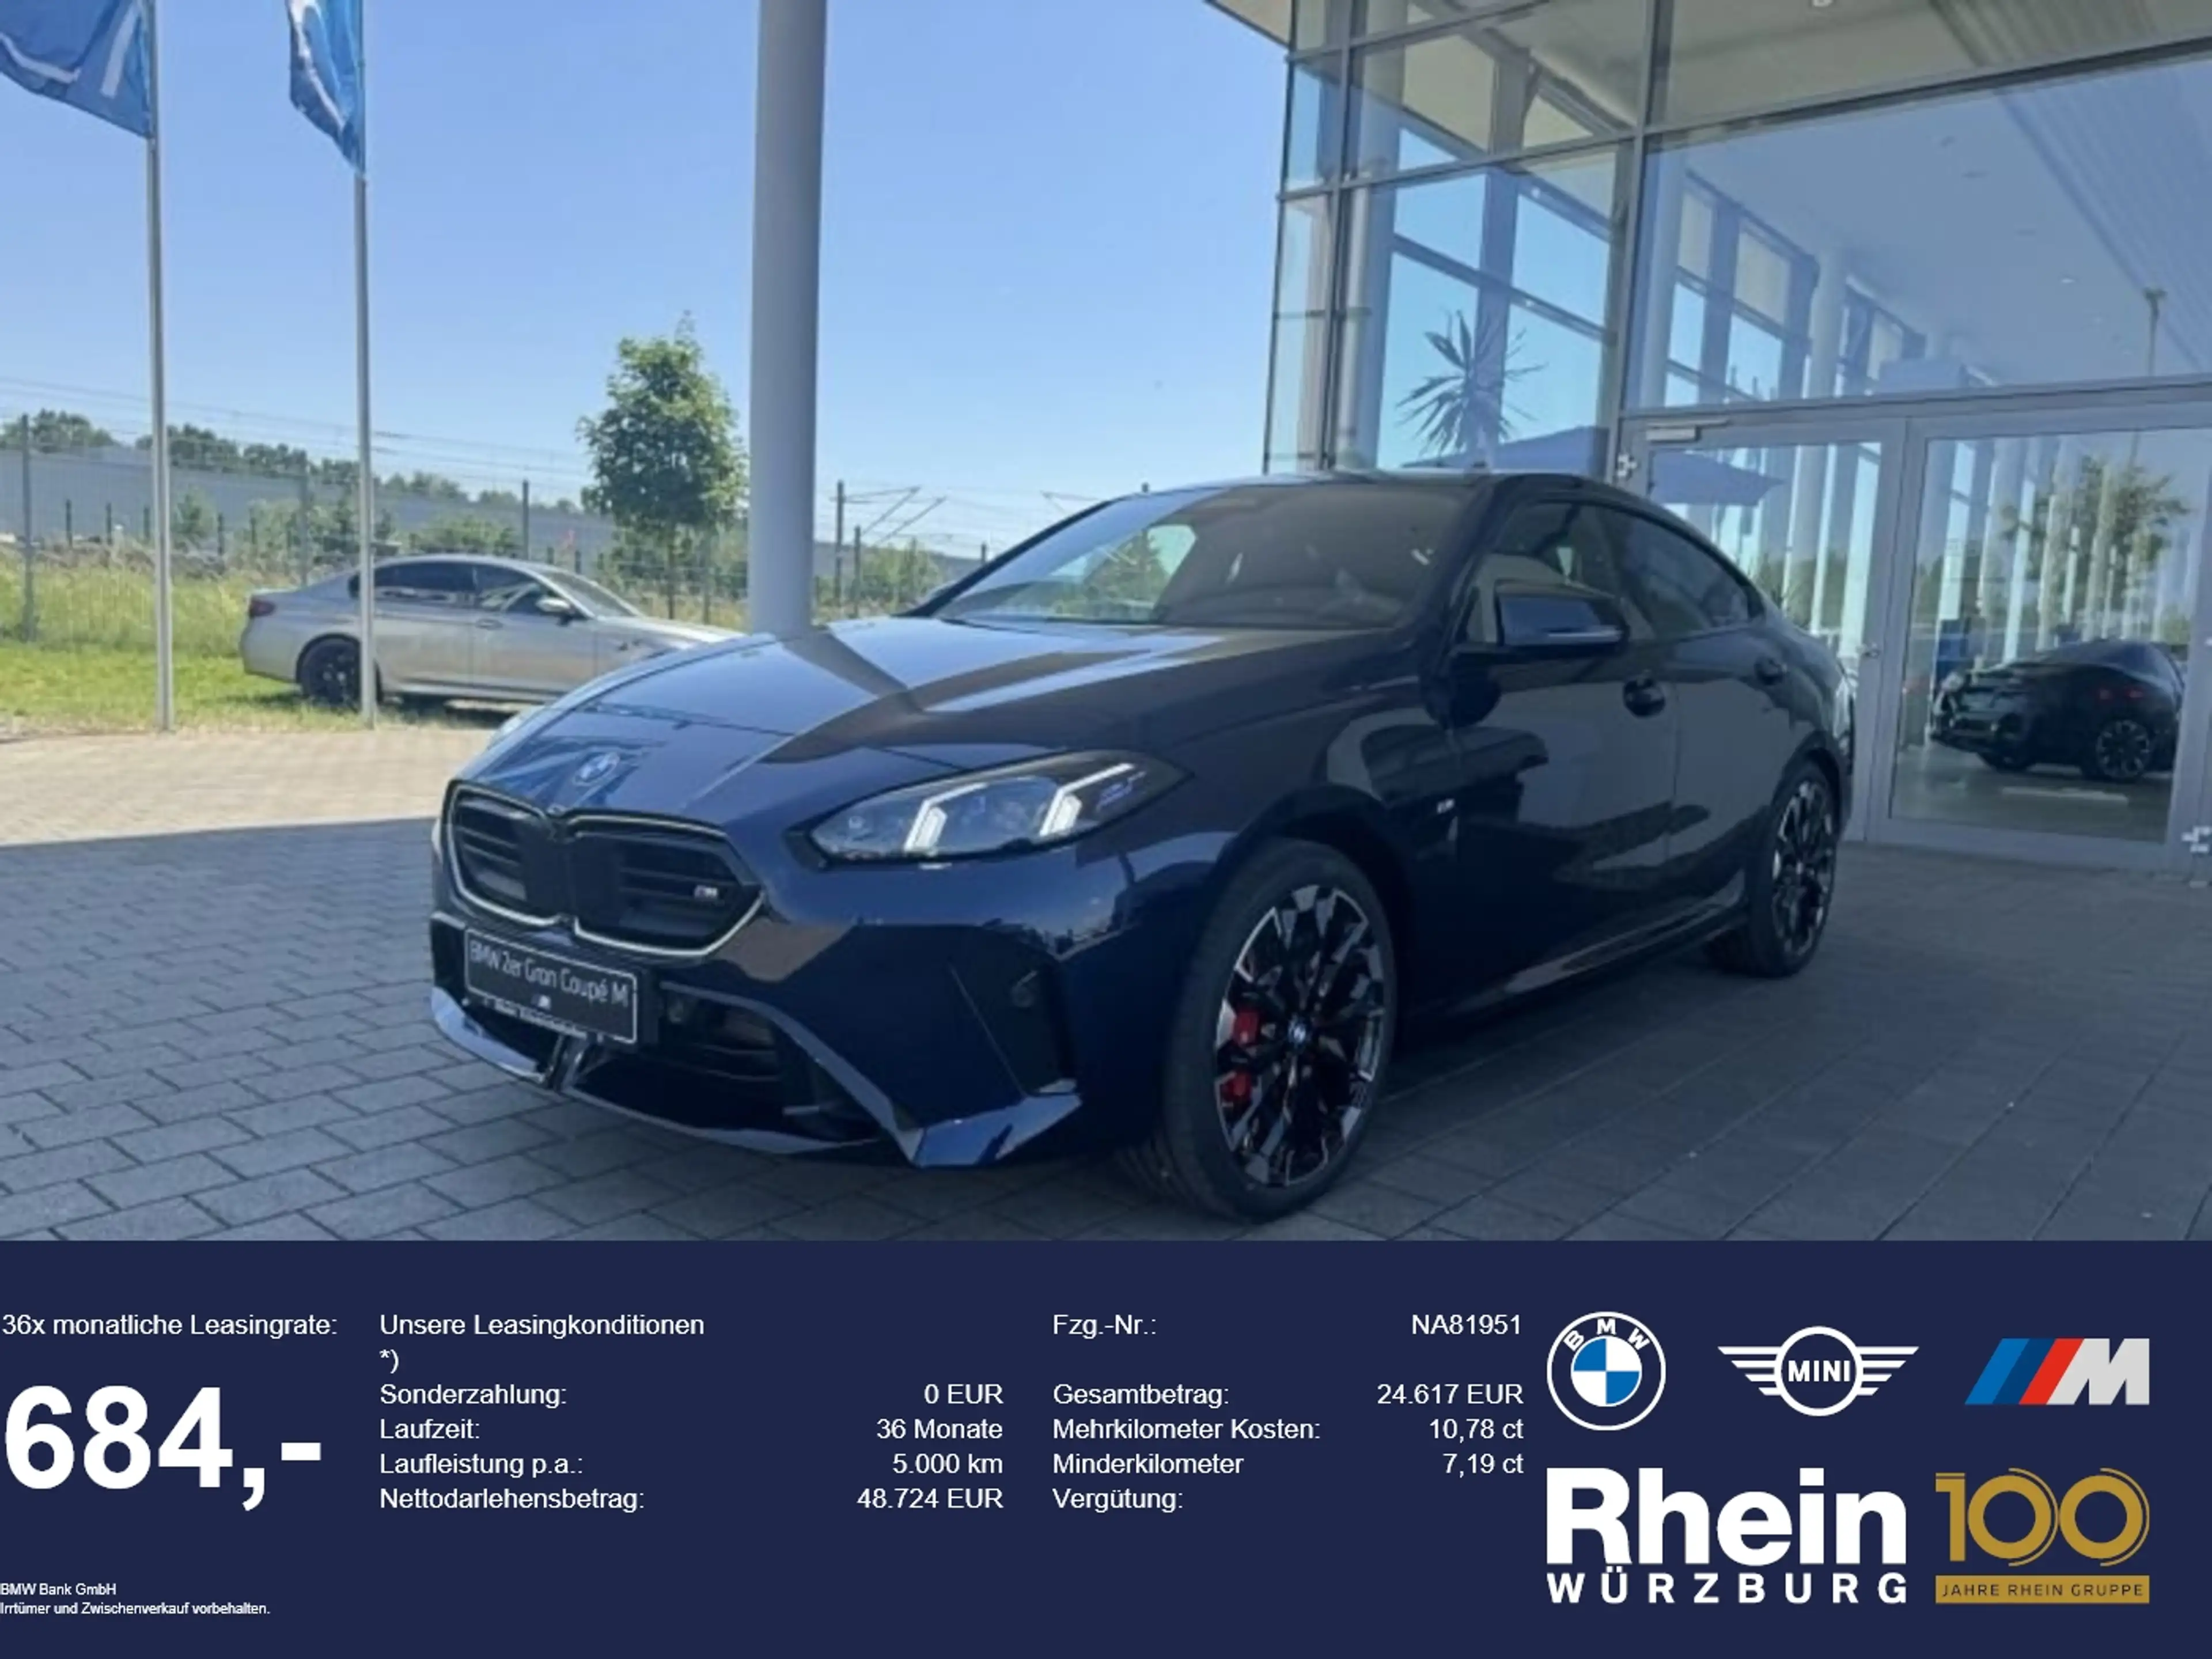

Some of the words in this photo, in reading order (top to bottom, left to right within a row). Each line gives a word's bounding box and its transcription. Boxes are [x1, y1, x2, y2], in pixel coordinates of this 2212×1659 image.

[469, 940, 499, 970] BMW
[501, 951, 521, 977] 2er
[524, 959, 558, 988] Gran
[560, 968, 608, 1003] Coupé
[611, 982, 629, 1007] M
